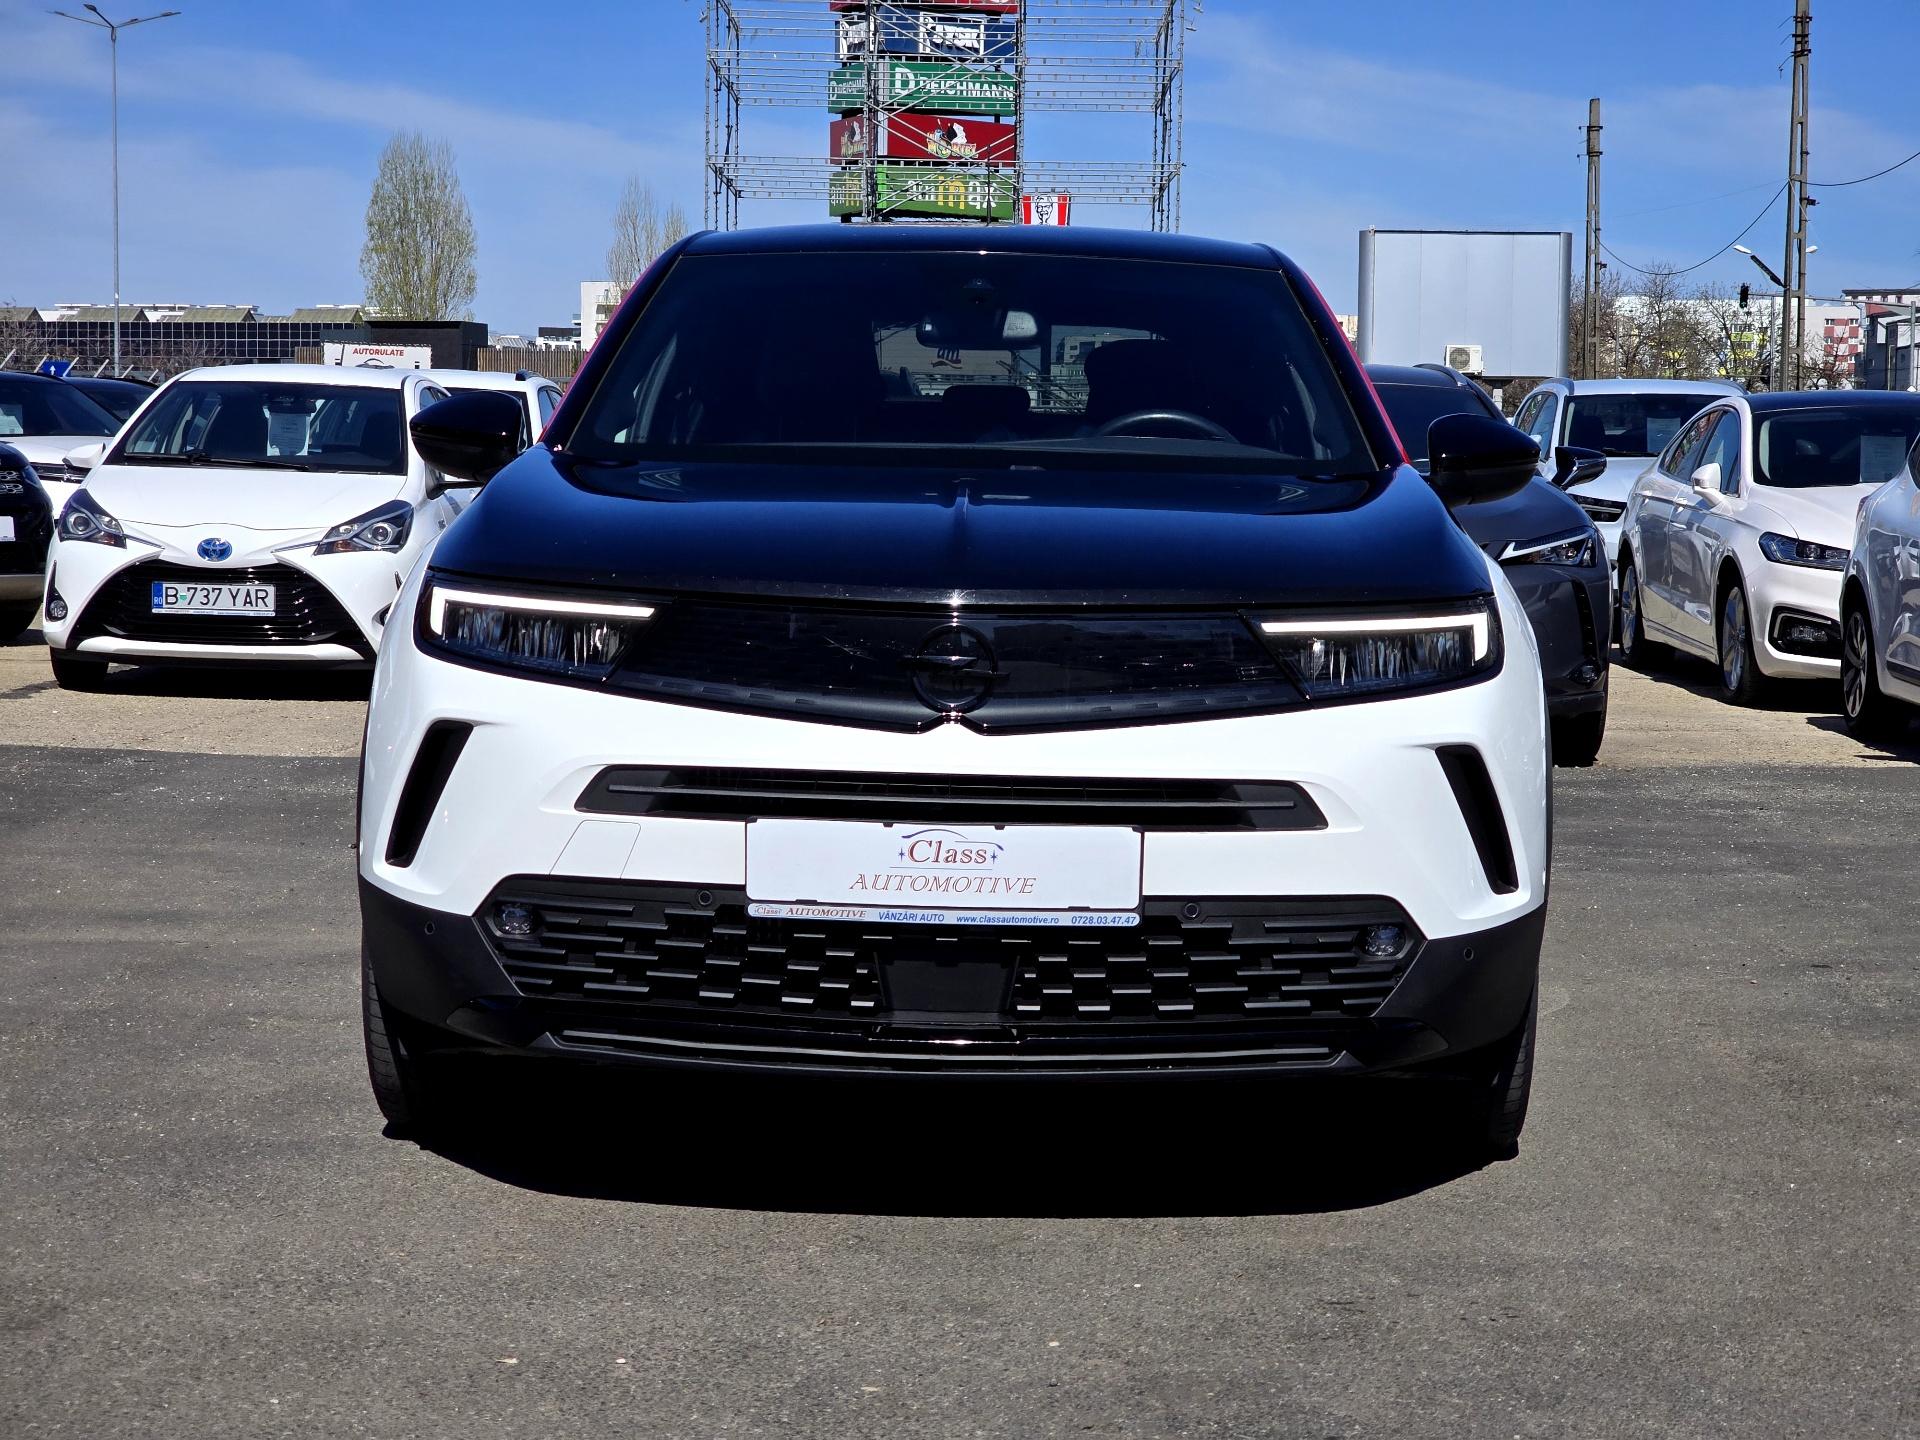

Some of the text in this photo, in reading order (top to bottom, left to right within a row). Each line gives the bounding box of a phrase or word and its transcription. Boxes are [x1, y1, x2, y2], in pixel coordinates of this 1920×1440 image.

[352, 348, 404, 356] AUTORULATE
[228, 588, 268, 607] YAR
[908, 839, 987, 864] Class
[849, 873, 1037, 894] AUTOMOTIVE
[786, 907, 867, 918] AUTOMOTIVE
[919, 913, 945, 922] AUTO
[956, 915, 1059, 925] www.classautomotive.ro
[1071, 915, 1136, 925] 0728.03.47.47
